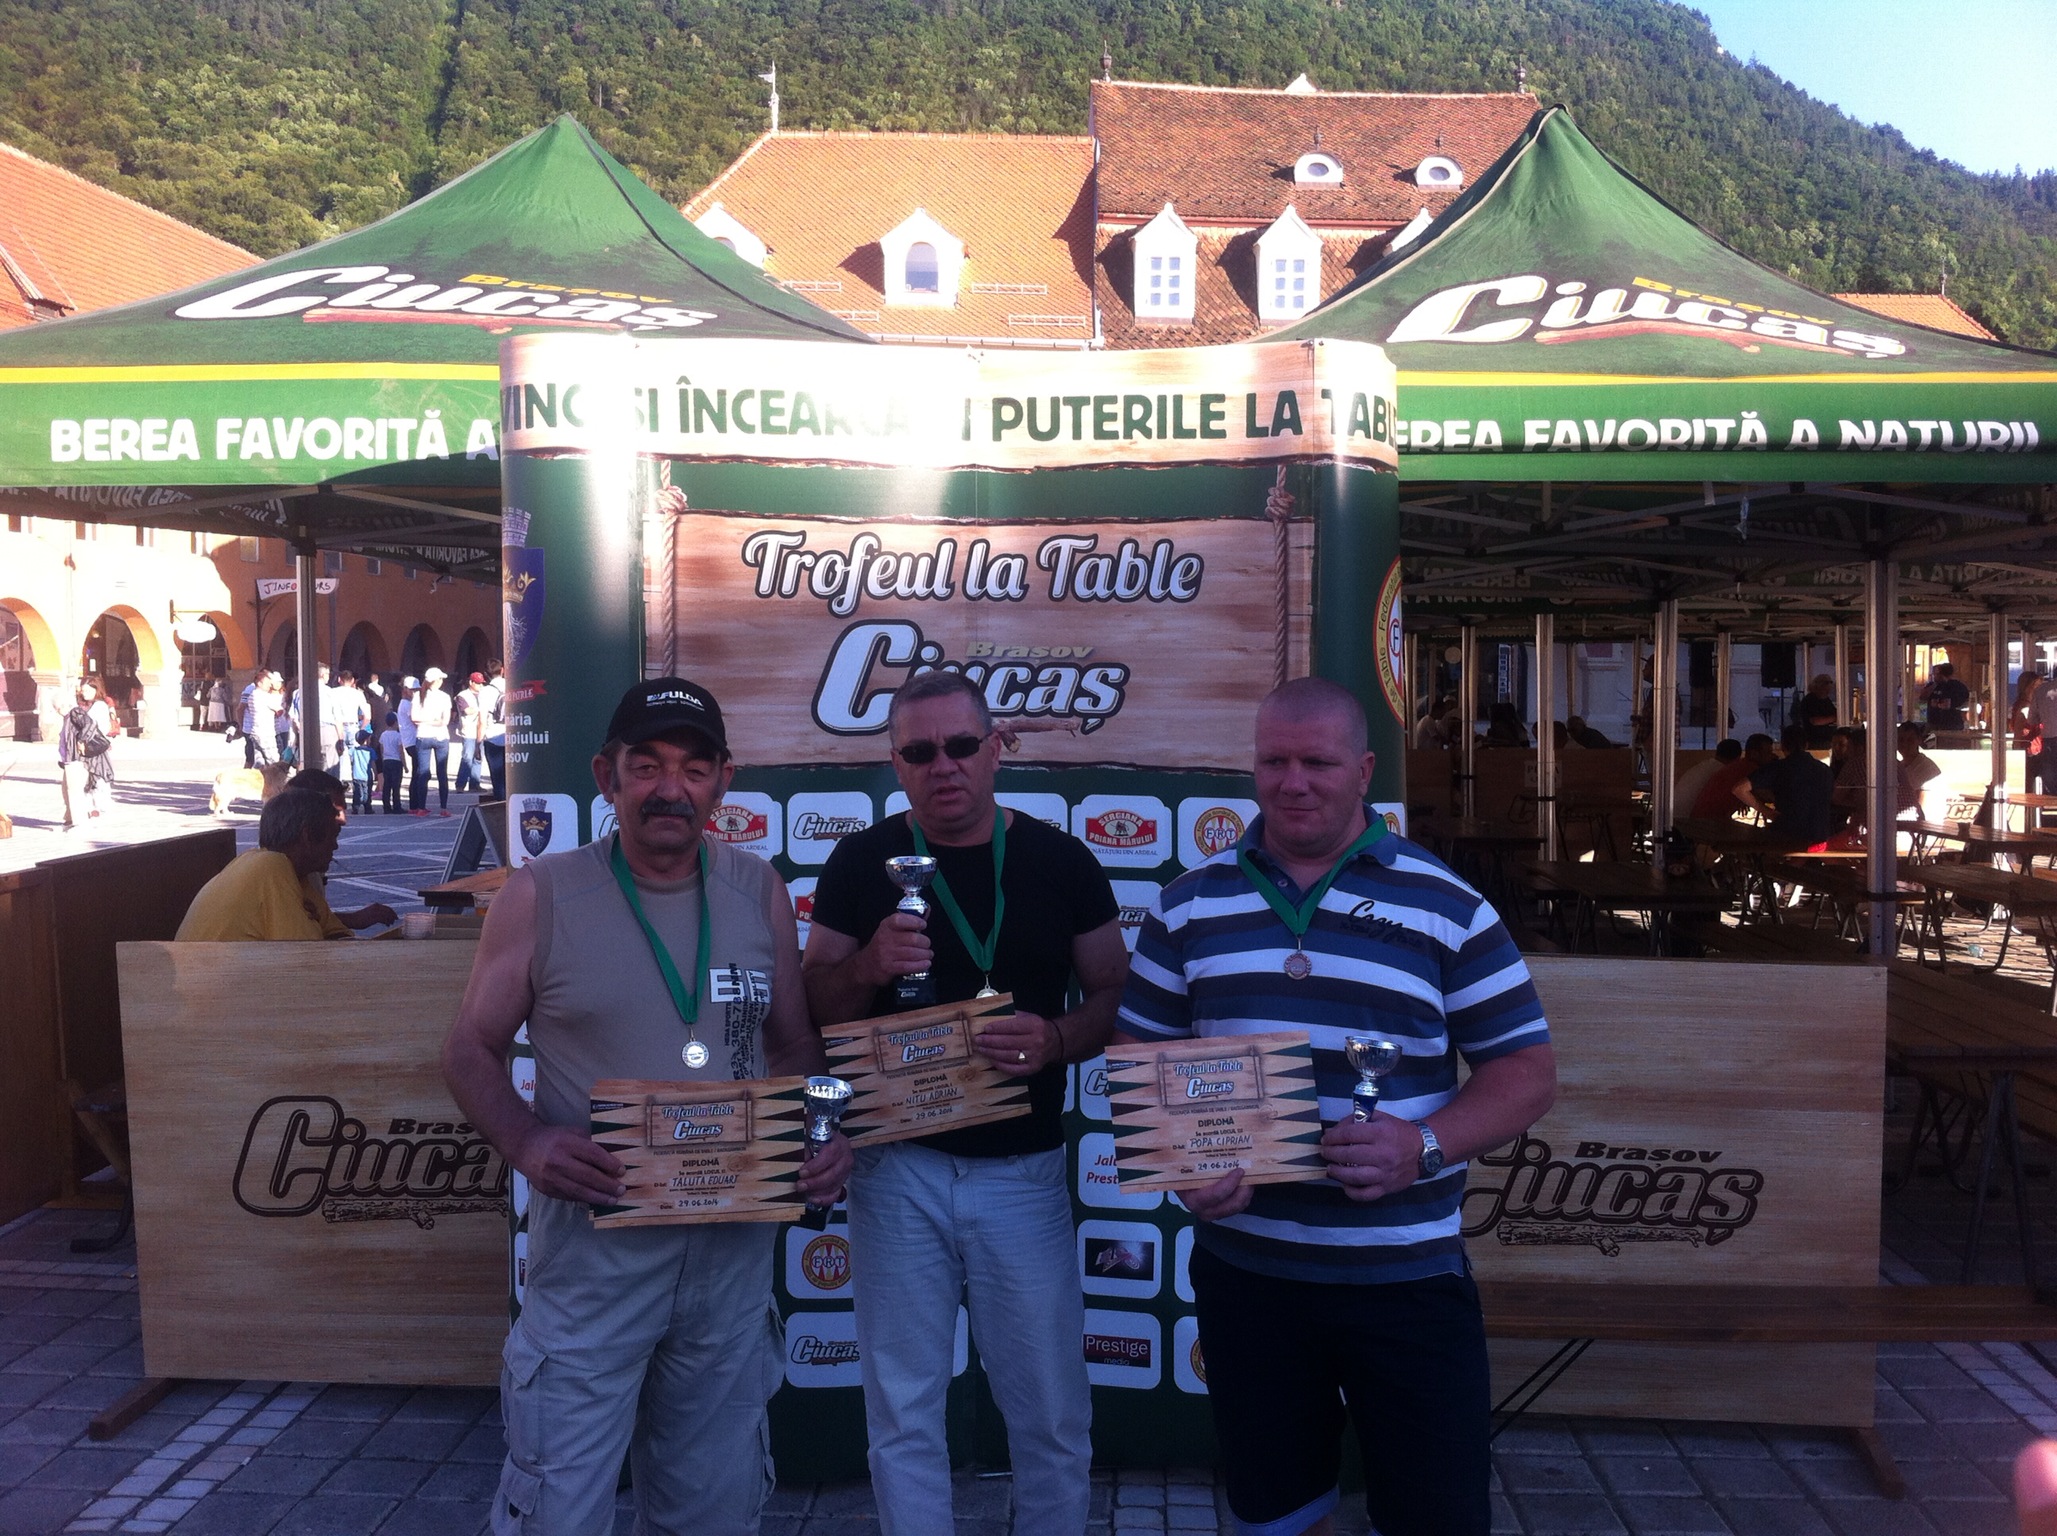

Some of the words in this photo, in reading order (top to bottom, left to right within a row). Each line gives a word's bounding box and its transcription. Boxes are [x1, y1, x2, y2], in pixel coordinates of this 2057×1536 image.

[992, 393, 1227, 442] PUTERILE
[1246, 390, 1303, 439] LA
[1321, 388, 1396, 448] TABL
[50, 418, 200, 463] BEREA
[216, 409, 449, 462] FAVORITĂ
[466, 418, 499, 461] A
[1785, 420, 1819, 453] A
[1838, 420, 2040, 454] NATURII
[742, 529, 957, 619] Trofeul
[961, 538, 1029, 601] la
[1037, 534, 1205, 603] Table
[965, 641, 1095, 666] Brașov
[388, 1118, 477, 1142] Braș
[1190, 1137, 1213, 1148] POPA
[1216, 1135, 1251, 1146] CIPRIAN
[232, 1096, 508, 1217] Ciuca
[1575, 1142, 1723, 1168] Brașov
[1086, 1335, 1148, 1358] Prestige
[1103, 1357, 1130, 1366] media
